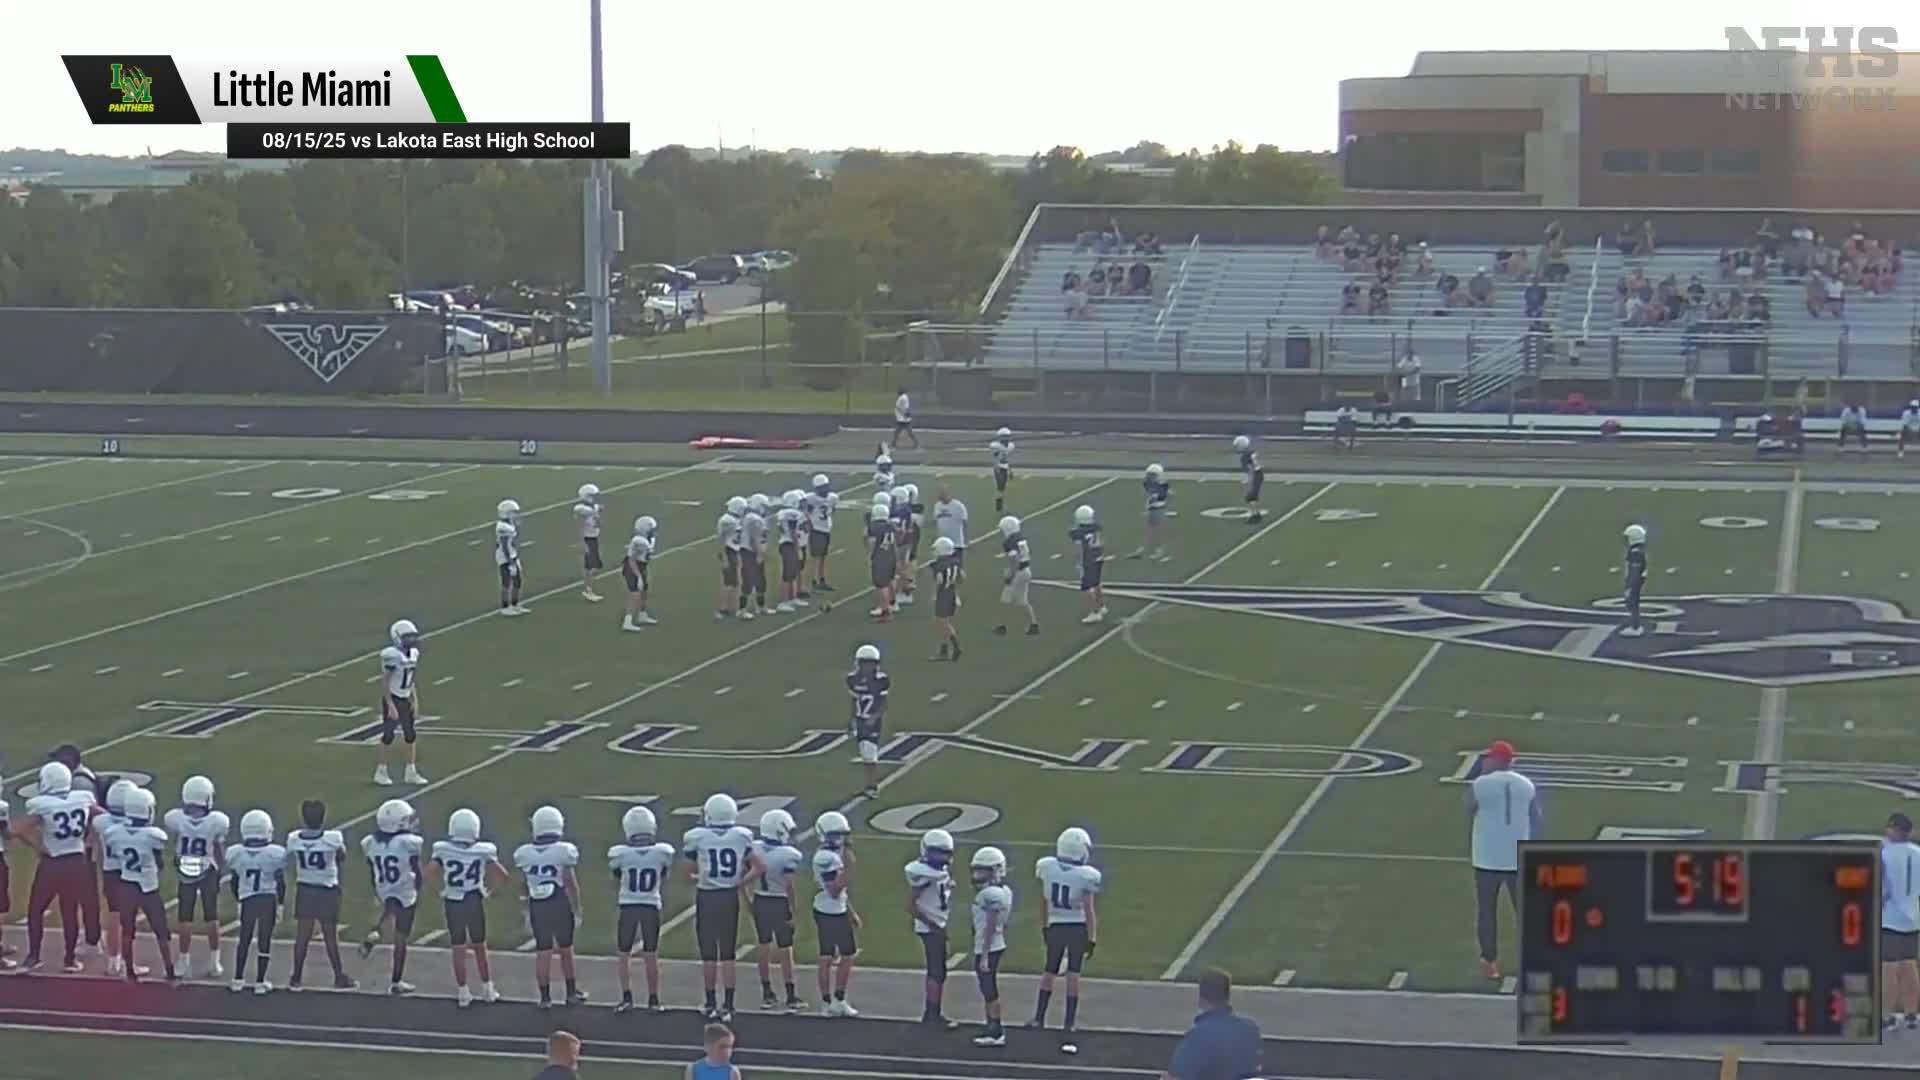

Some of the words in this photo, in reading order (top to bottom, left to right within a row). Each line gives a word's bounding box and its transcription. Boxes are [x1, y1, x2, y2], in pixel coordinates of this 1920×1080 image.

[103, 441, 118, 453] 10
[53, 808, 86, 840] 33
[123, 847, 142, 872] 2
[297, 850, 326, 870] 14
[376, 855, 400, 884] 16
[446, 858, 482, 888] 24
[708, 848, 737, 879] 19
[246, 868, 262, 891] 7
[628, 867, 657, 893] 10
[1673, 852, 1745, 905] 5:19
